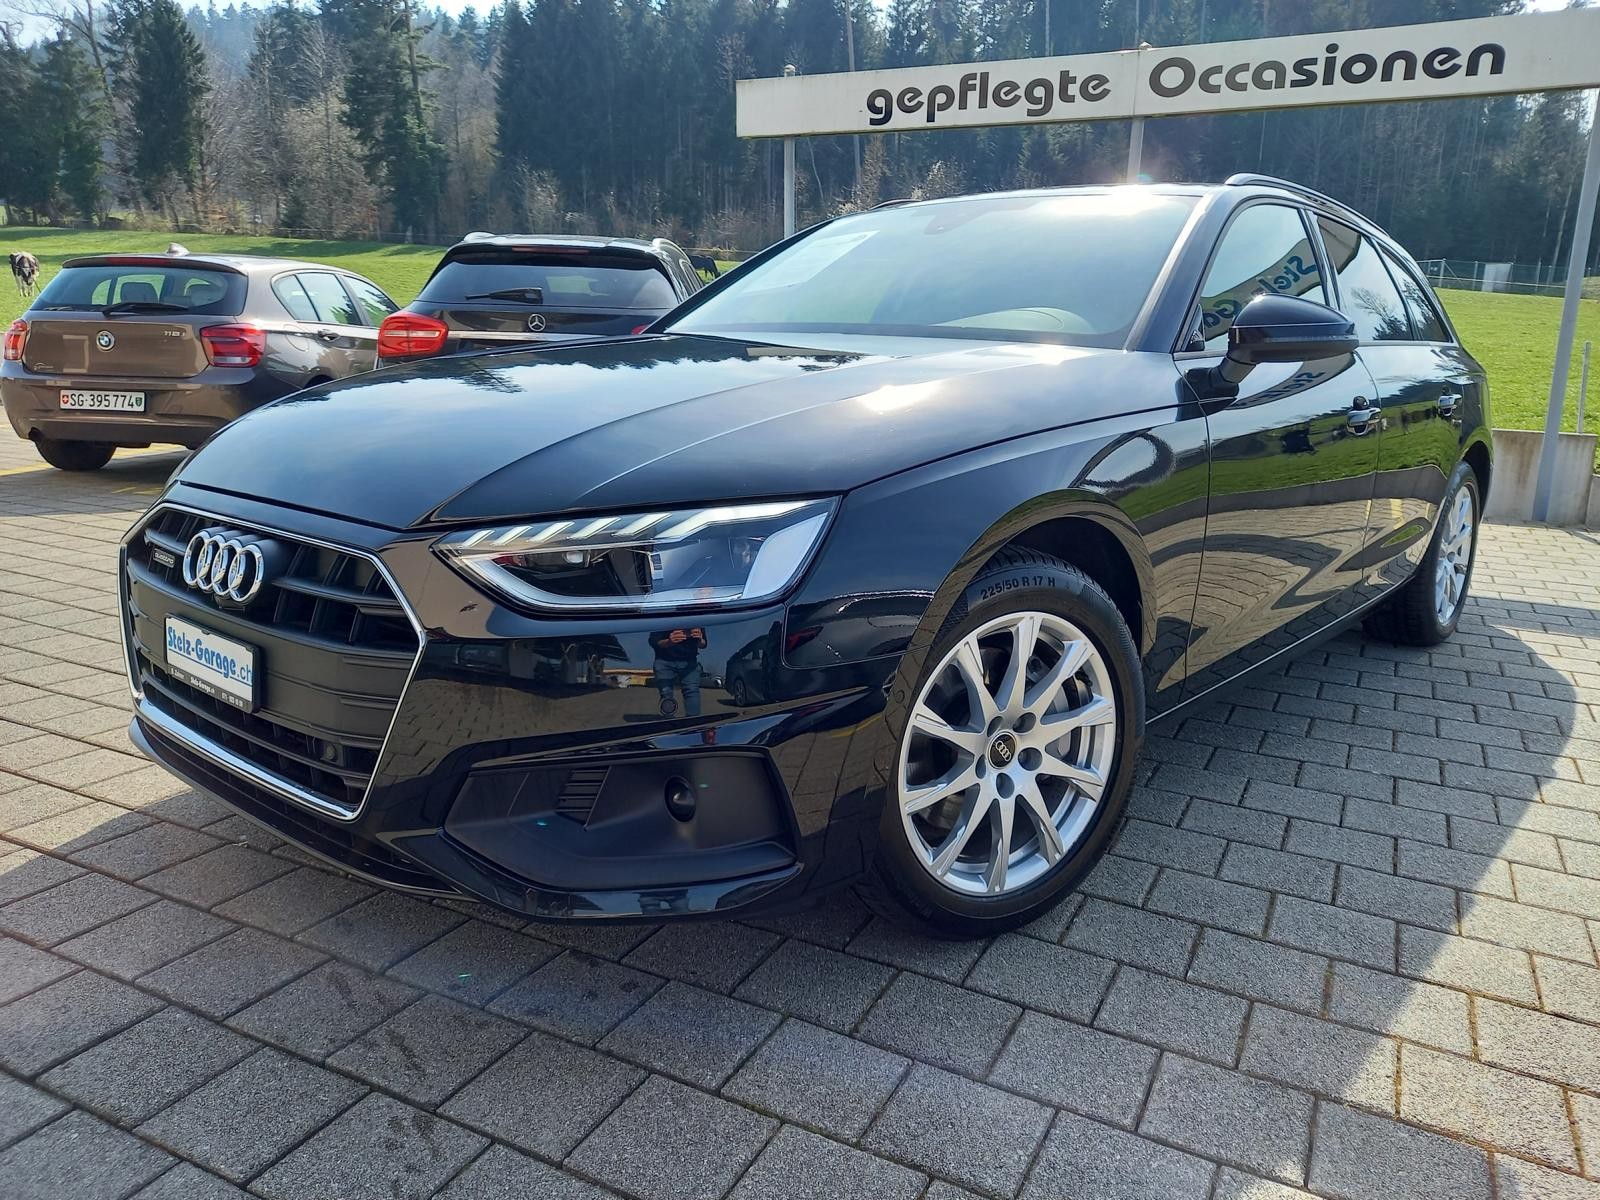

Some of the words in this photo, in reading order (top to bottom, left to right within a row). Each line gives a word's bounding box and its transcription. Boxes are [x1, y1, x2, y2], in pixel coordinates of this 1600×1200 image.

[866, 69, 1112, 126] gepflegte
[1148, 43, 1506, 98] Occasionen
[980, 578, 1019, 600] 225/50
[1022, 576, 1030, 587] R
[1033, 575, 1043, 586] 17
[1048, 576, 1056, 587] H
[167, 626, 252, 682] Stelz-Garage.ch
